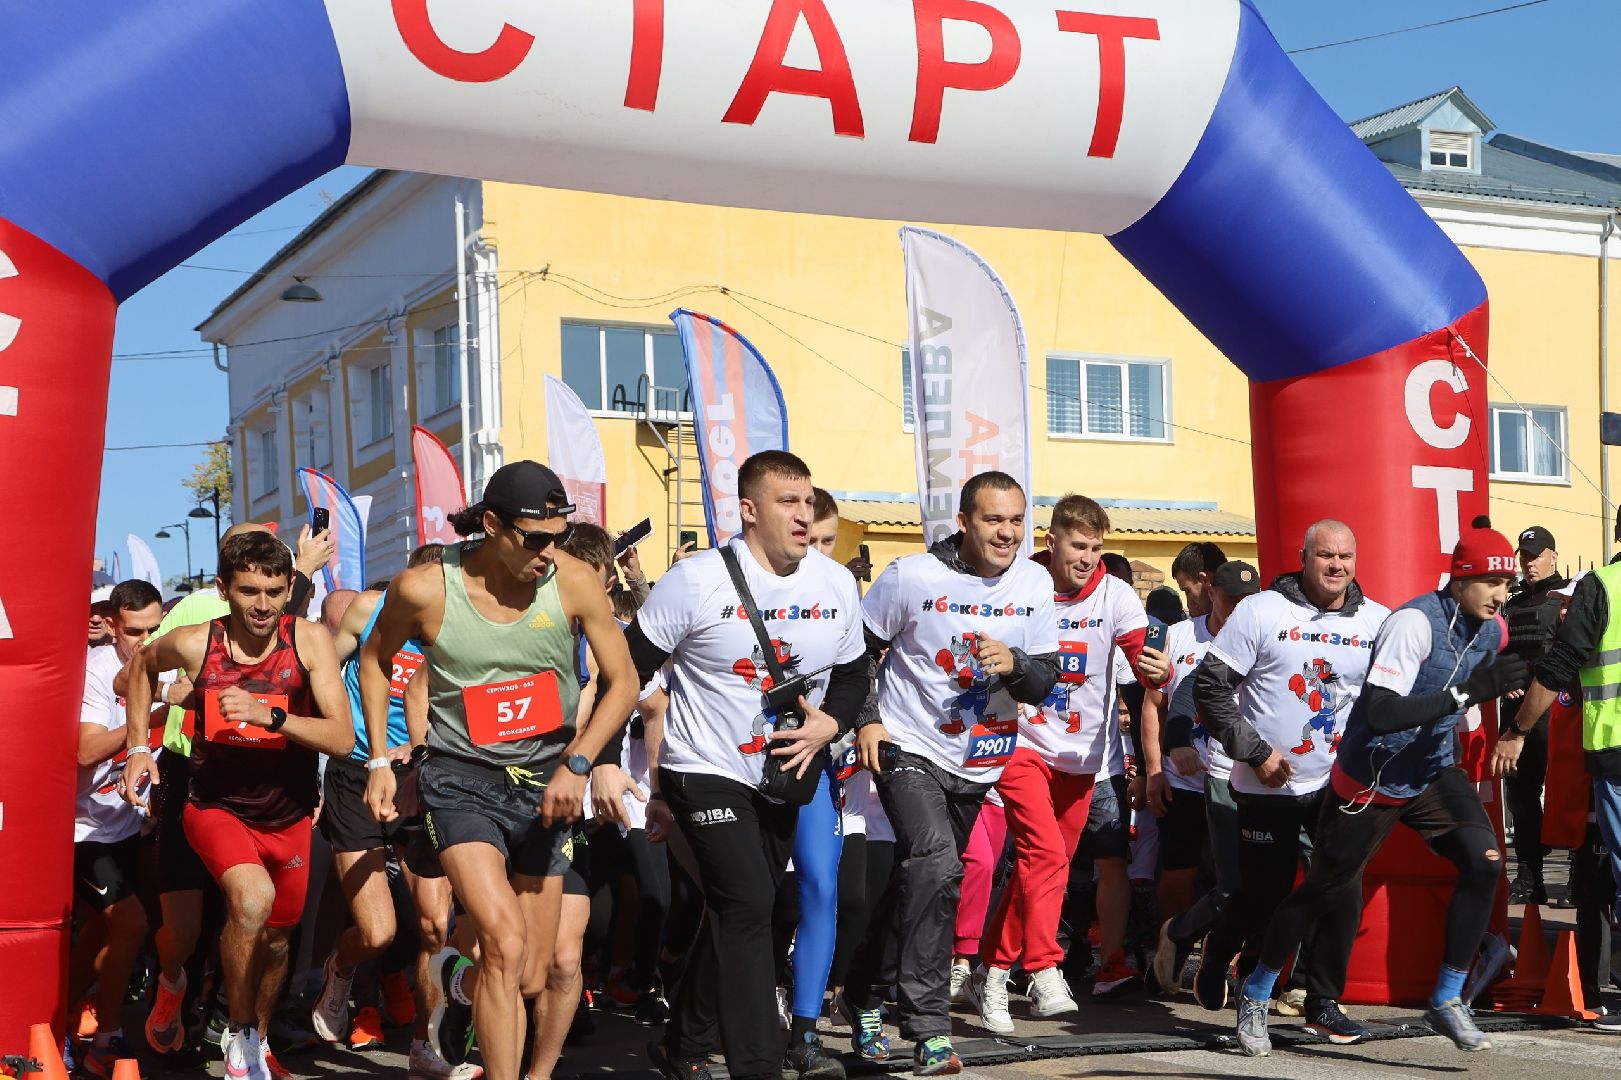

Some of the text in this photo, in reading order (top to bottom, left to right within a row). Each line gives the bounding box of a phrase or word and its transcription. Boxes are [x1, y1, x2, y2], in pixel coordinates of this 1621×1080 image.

[1487, 556, 1517, 572] RU
[1057, 617, 1103, 630] Забег
[497, 696, 533, 723] 57
[972, 737, 1012, 757] 2901
[707, 807, 736, 821] IBA
[1253, 830, 1274, 841] IBA
